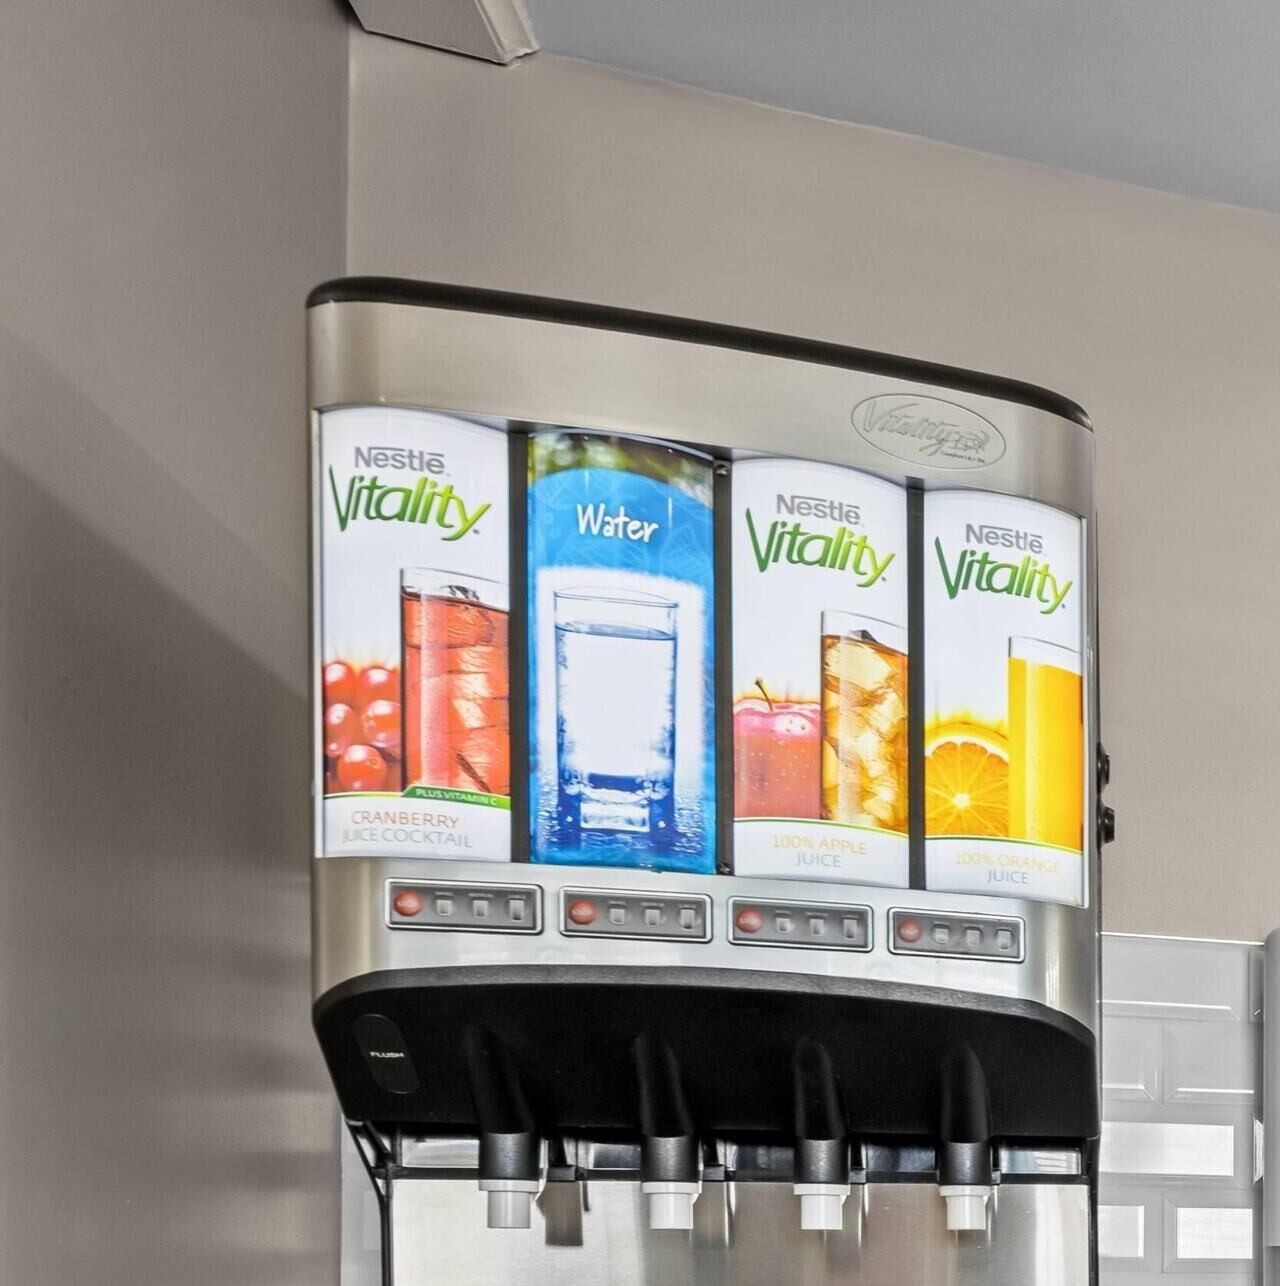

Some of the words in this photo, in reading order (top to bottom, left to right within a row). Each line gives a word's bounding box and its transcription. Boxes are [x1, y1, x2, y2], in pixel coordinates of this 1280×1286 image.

[329, 464, 492, 541] Vitality
[576, 502, 659, 543] Water
[745, 507, 896, 588] Vitality
[934, 536, 1073, 615] Vitality
[415, 788, 443, 799] PLUS
[443, 790, 489, 804] VITAMIN
[490, 797, 498, 806] C
[351, 810, 460, 829] CRANBERRY
[342, 828, 378, 844] JUICE
[381, 828, 474, 849] COCKTAIL
[772, 834, 814, 849] 100%
[818, 837, 868, 855] APPLE
[796, 853, 841, 868] JUICE
[956, 851, 997, 867] 100%
[998, 854, 1060, 874] ORANGE
[987, 869, 1030, 884] JUICE
